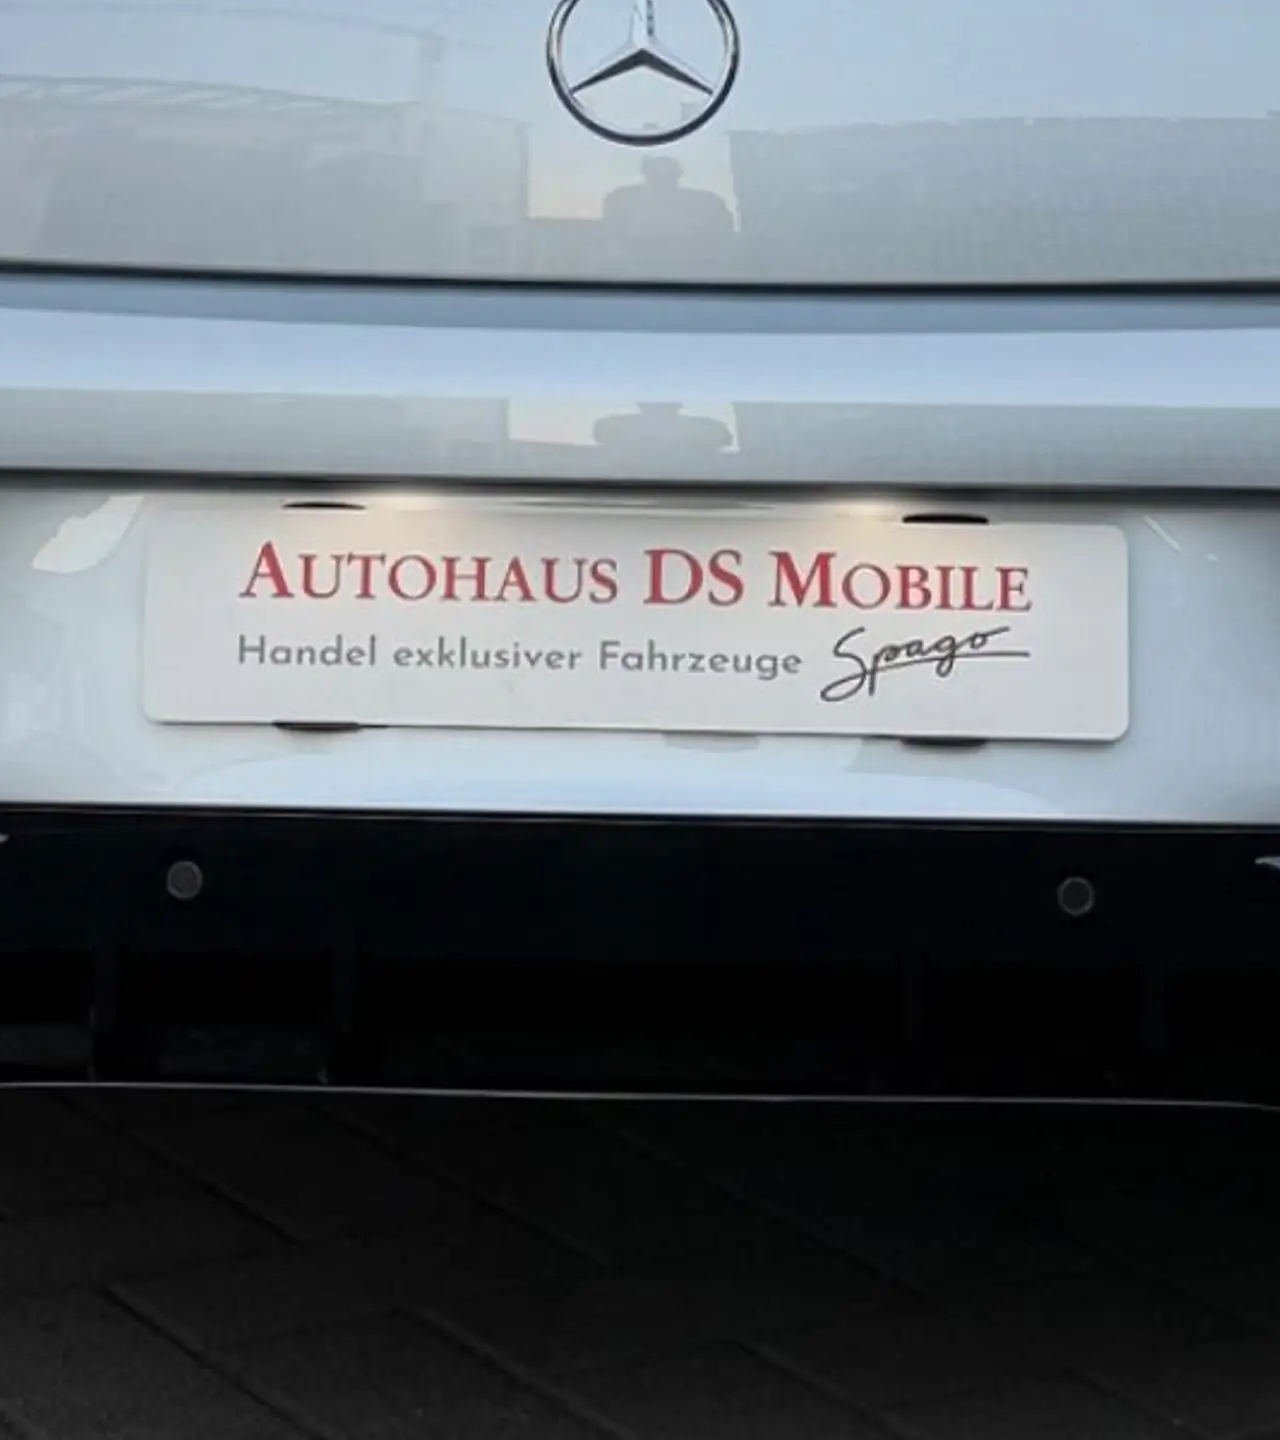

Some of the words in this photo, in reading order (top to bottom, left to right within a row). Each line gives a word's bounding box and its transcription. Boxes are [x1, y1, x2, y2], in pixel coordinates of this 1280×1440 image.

[238, 540, 618, 605] AUTOHAUS
[643, 548, 745, 607] DS
[767, 550, 1033, 613] MOBILE
[238, 633, 377, 667] Handel
[393, 635, 583, 671] exklusiver
[600, 638, 803, 682] Fahrzeuge
[820, 626, 1031, 703] Spago
